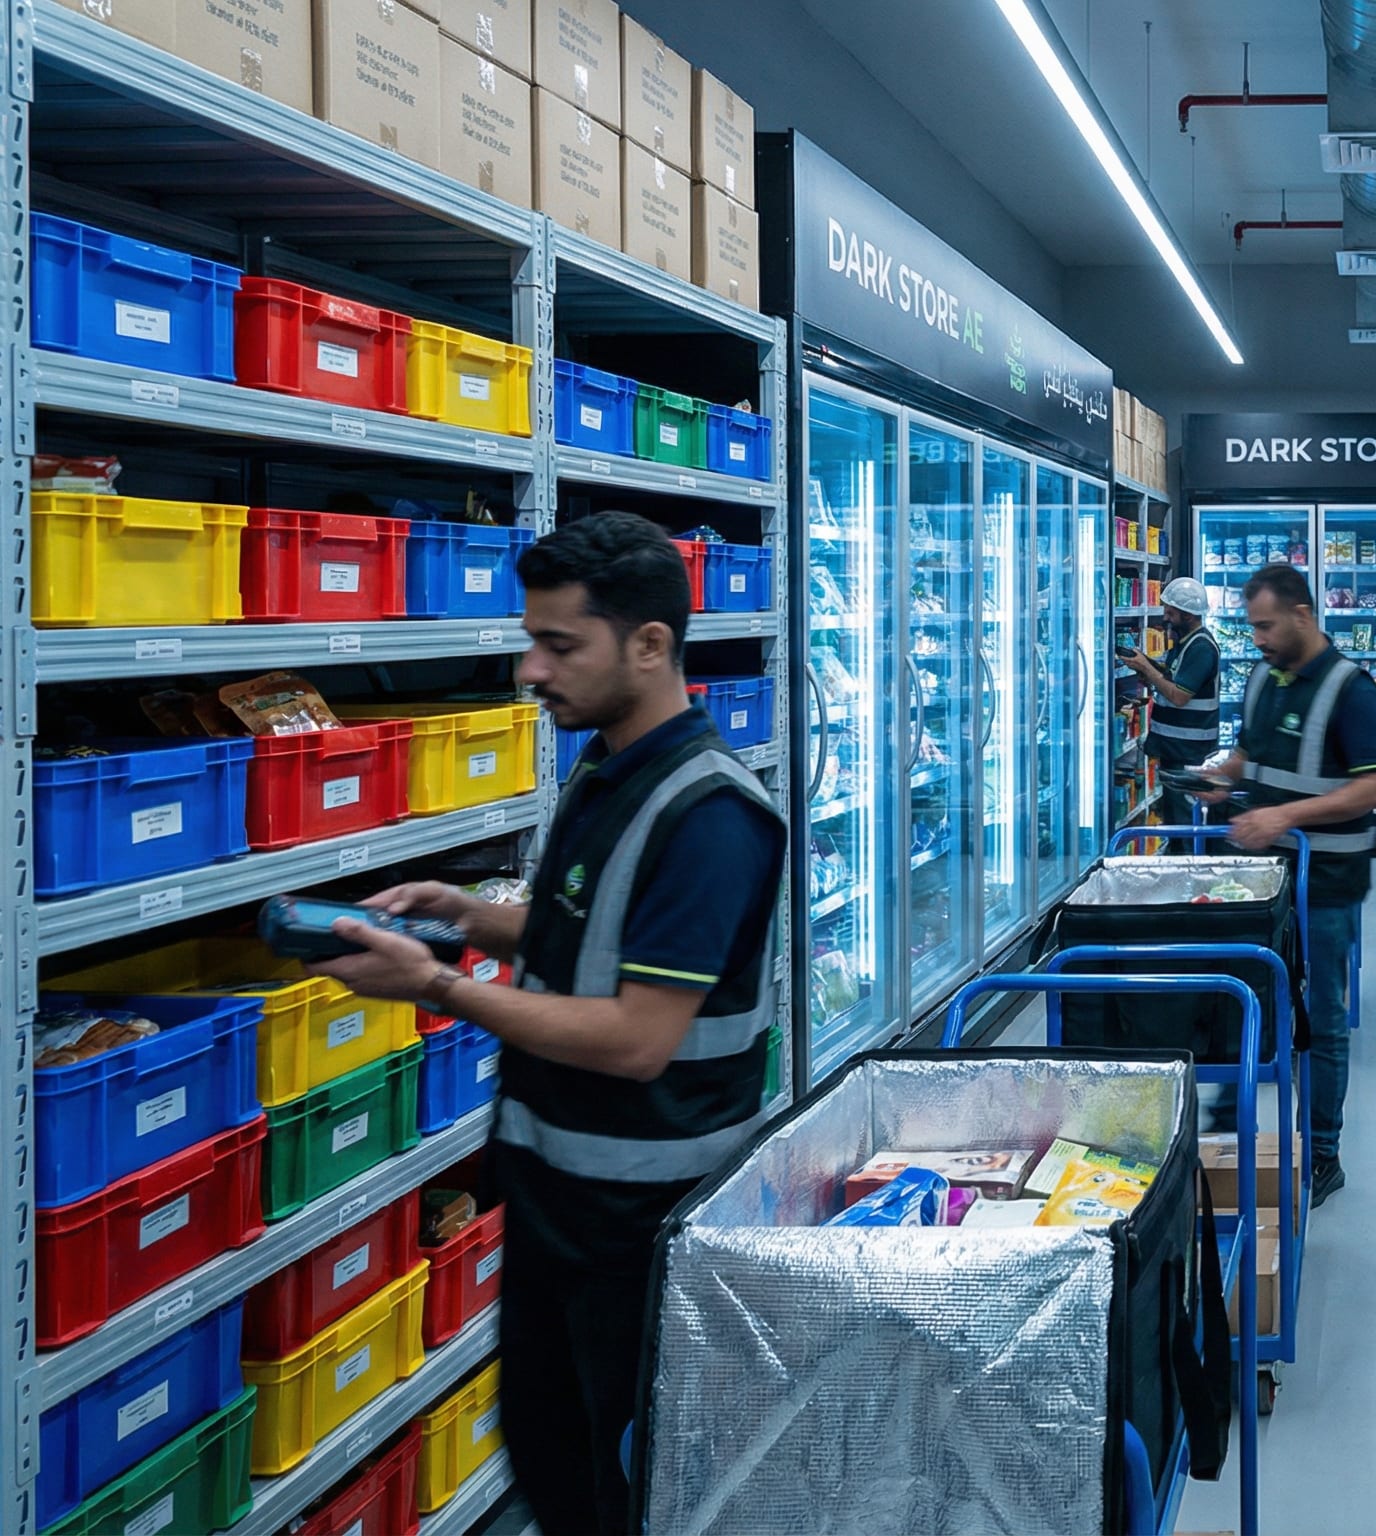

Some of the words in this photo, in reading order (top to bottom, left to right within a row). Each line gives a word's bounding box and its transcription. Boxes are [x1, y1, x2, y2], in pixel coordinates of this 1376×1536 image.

[827, 217, 893, 304] DARK
[899, 264, 960, 341] STORE
[963, 307, 984, 354] AE
[1225, 437, 1312, 462] DARK
